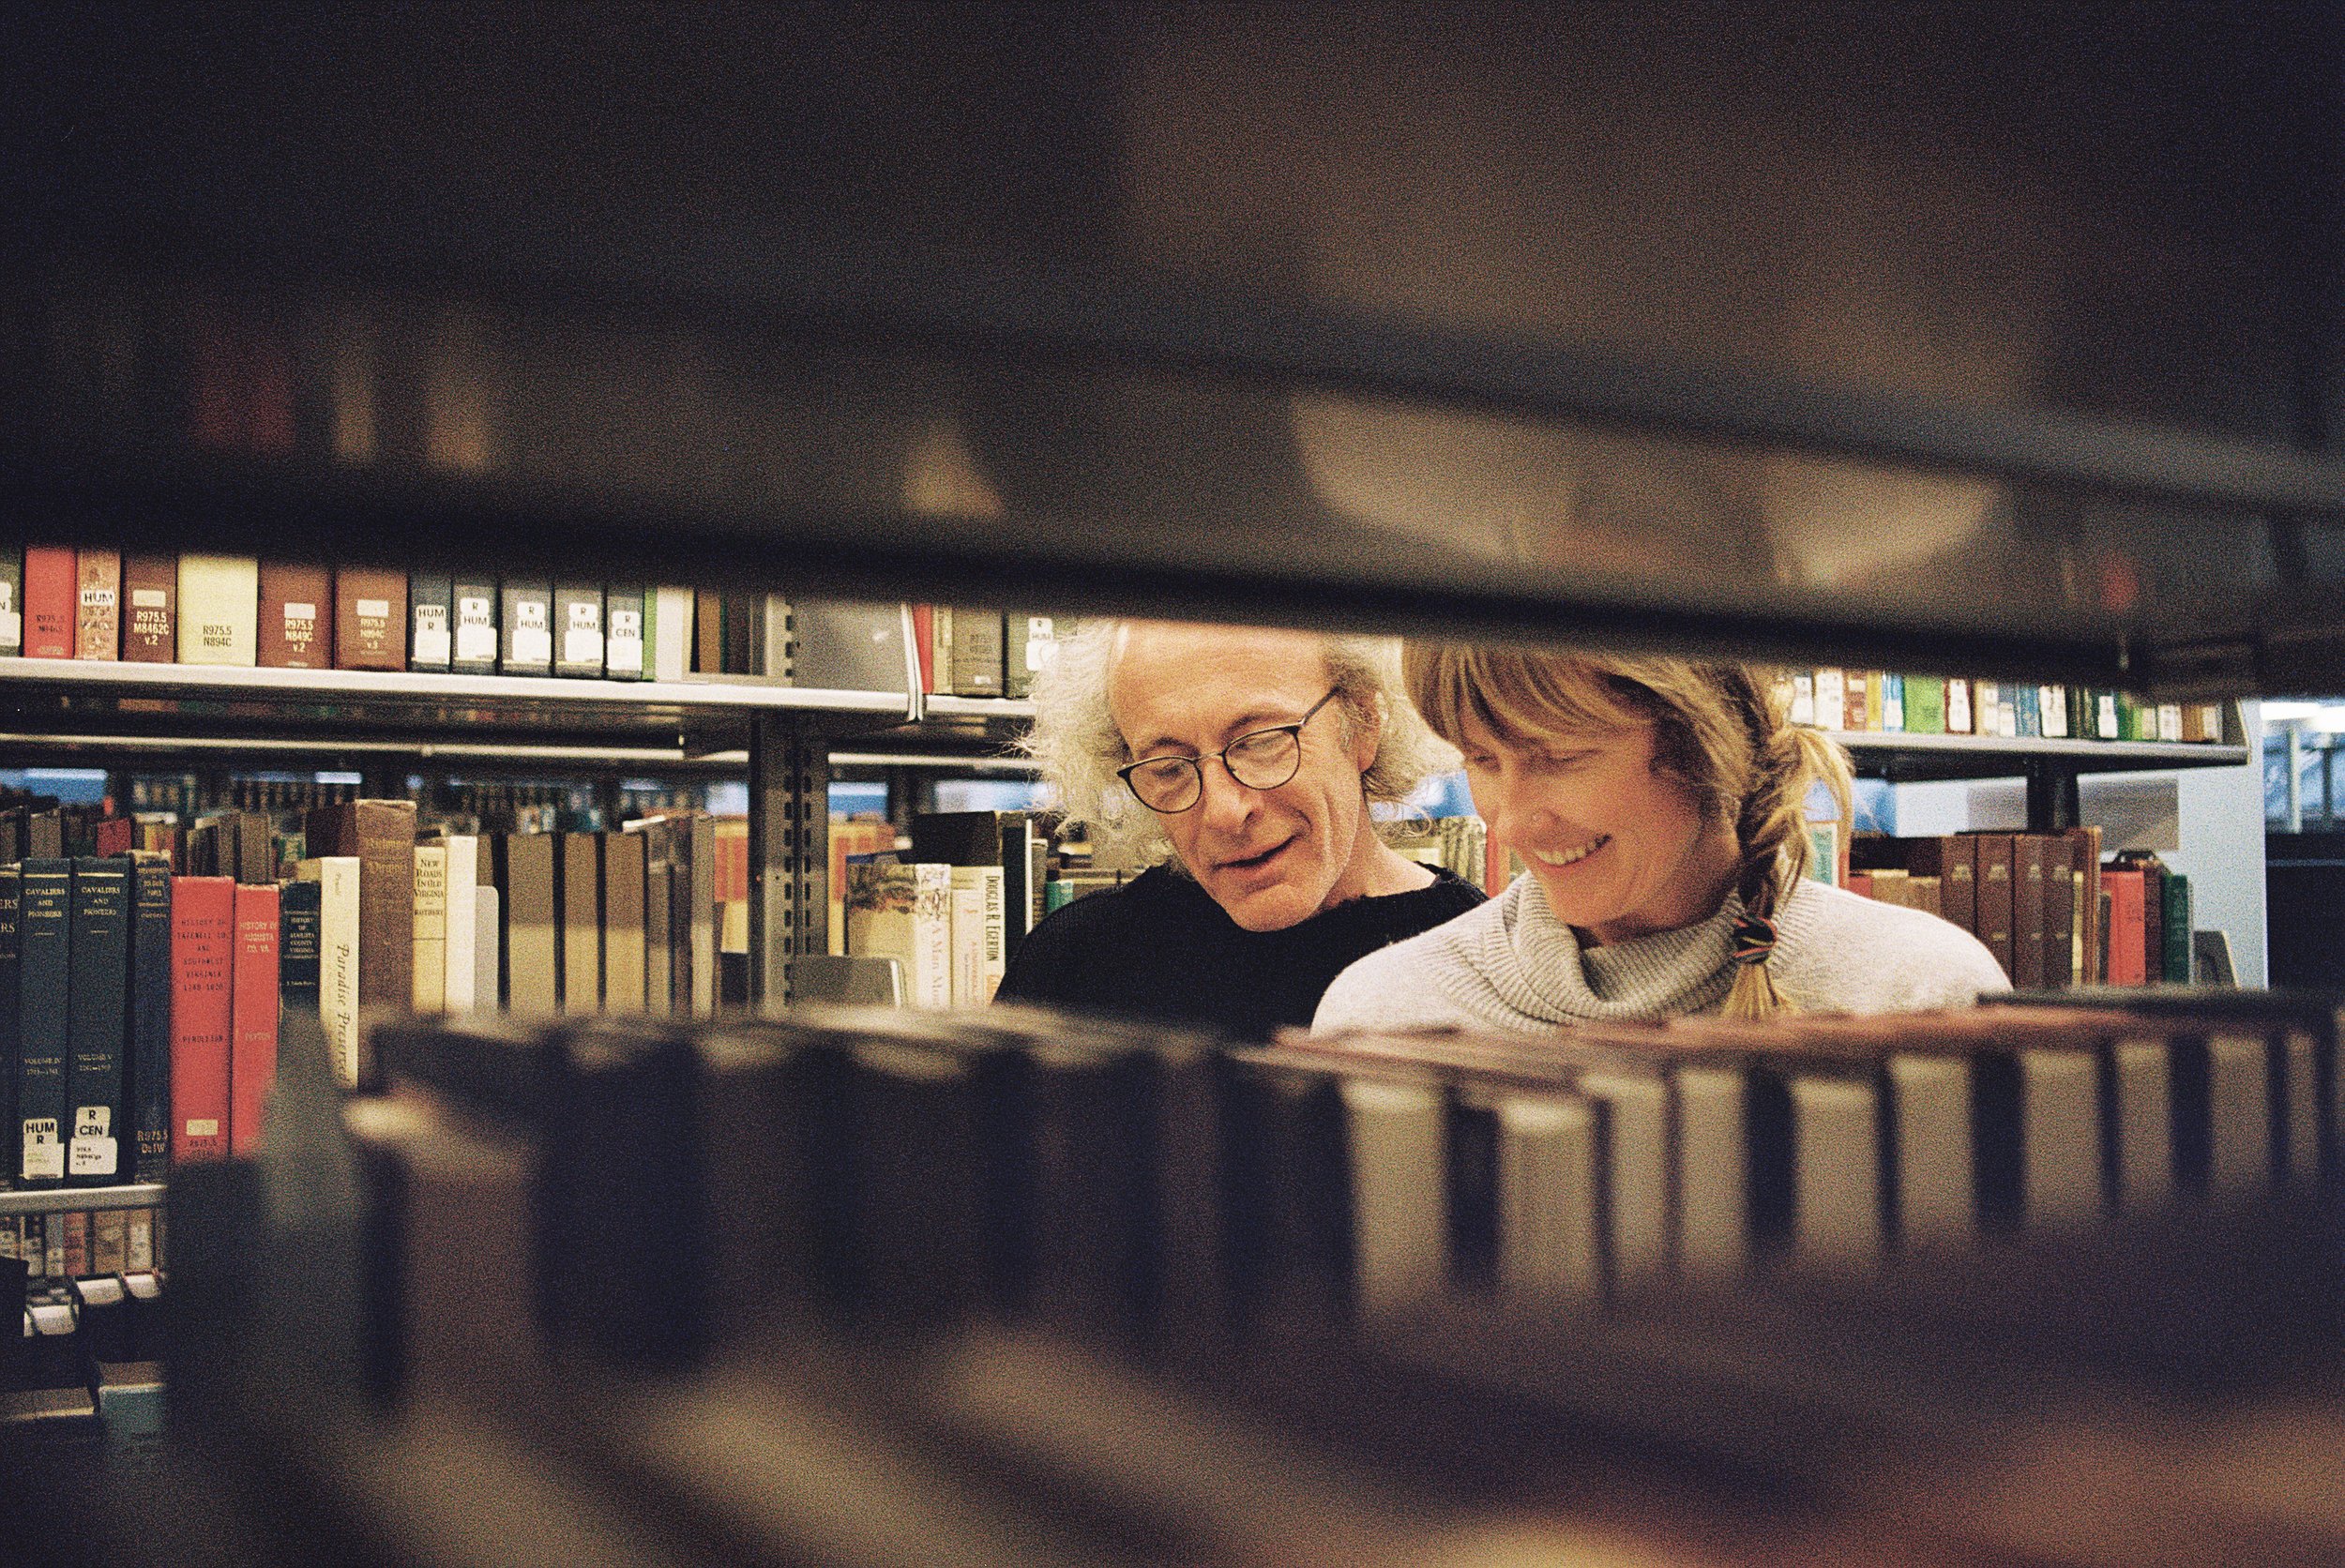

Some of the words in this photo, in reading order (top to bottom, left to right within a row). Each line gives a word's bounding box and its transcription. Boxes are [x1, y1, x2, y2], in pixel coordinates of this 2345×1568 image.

[84, 594, 113, 603] HUM
[472, 602, 478, 611] R
[528, 606, 535, 615] R
[136, 611, 167, 623] R975.5
[418, 609, 445, 618] HUM
[580, 608, 586, 616] R
[285, 619, 313, 630] R975.5
[463, 616, 488, 626] HUM
[521, 620, 543, 629] HUM
[625, 615, 630, 624] R
[134, 624, 170, 636] M8462C
[428, 622, 434, 630] R
[572, 621, 596, 630] HUM
[203, 626, 232, 636] R975.5
[615, 628, 635, 638] CEN
[144, 635, 159, 646] v.2
[204, 637, 232, 647] N894C
[986, 876, 1000, 912] DOUGLAS
[245, 933, 274, 942] AUGUSTA
[986, 927, 1001, 962] EGERTON
[337, 944, 350, 1005] Paradise
[337, 1012, 351, 1081] Preserved
[88, 1109, 97, 1120] R
[26, 1123, 54, 1134] HUM
[79, 1125, 103, 1136] CEN
[37, 1135, 44, 1145] R
